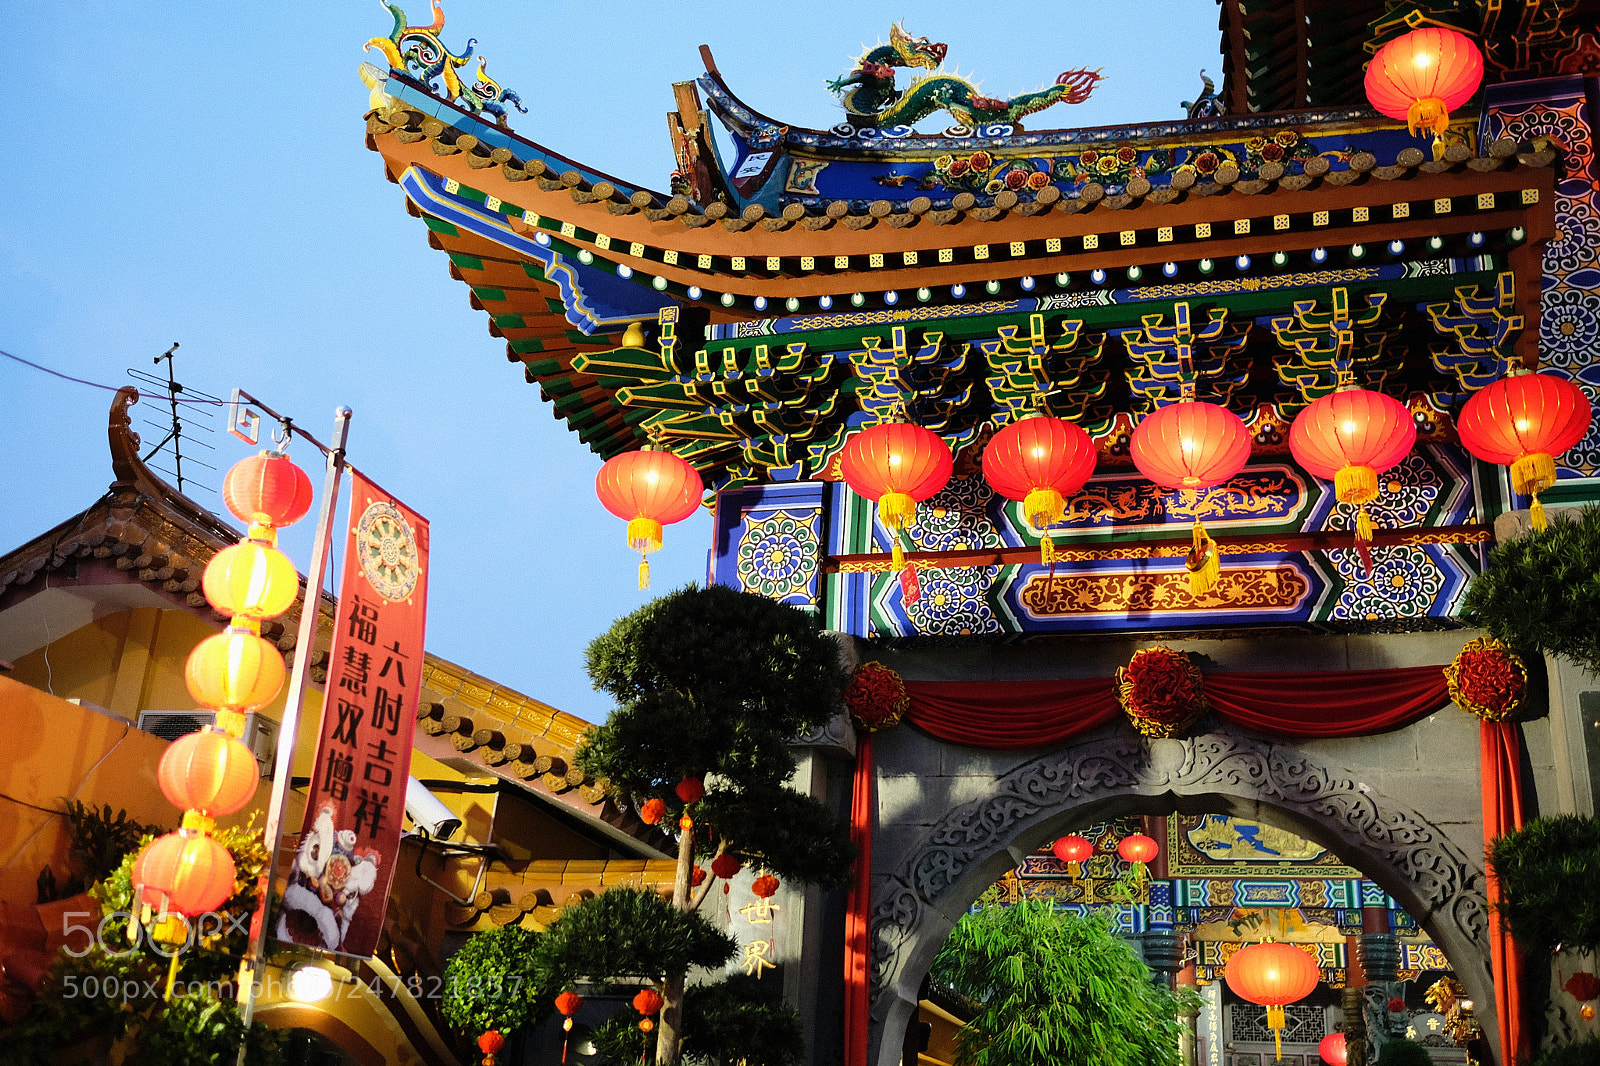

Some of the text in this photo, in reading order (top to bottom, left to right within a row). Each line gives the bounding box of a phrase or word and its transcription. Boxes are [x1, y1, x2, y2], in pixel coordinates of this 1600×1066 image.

[321, 595, 380, 803] 福慧双增
[352, 641, 410, 840] 六时吉祥
[738, 897, 780, 980] 世界
